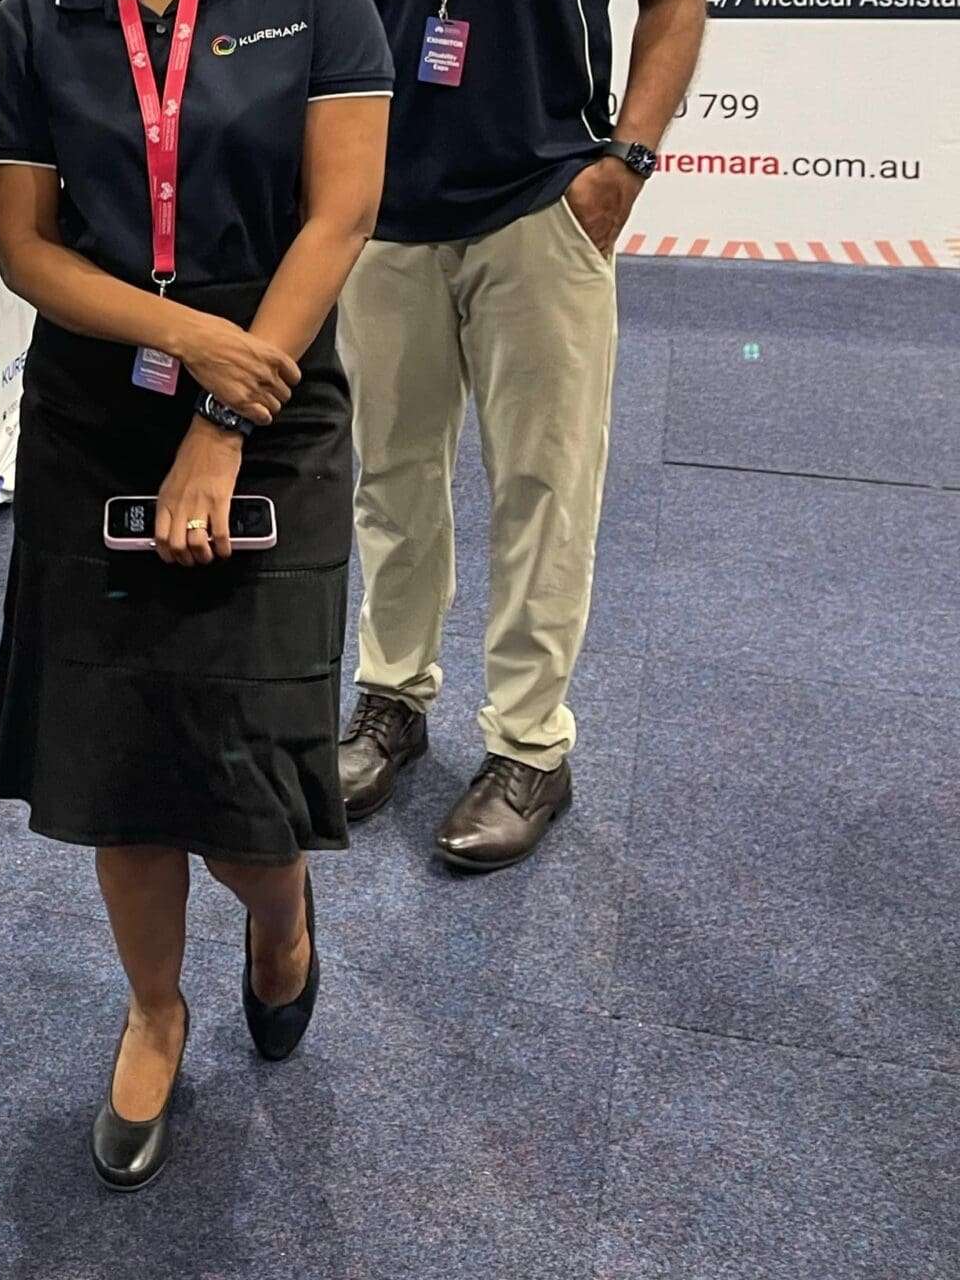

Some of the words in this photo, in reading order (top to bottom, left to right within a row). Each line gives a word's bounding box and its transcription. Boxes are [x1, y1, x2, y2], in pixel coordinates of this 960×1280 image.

[239, 20, 308, 47] KUREMARA
[698, 94, 760, 119] 799
[653, 152, 920, 180] uremara.com.au
